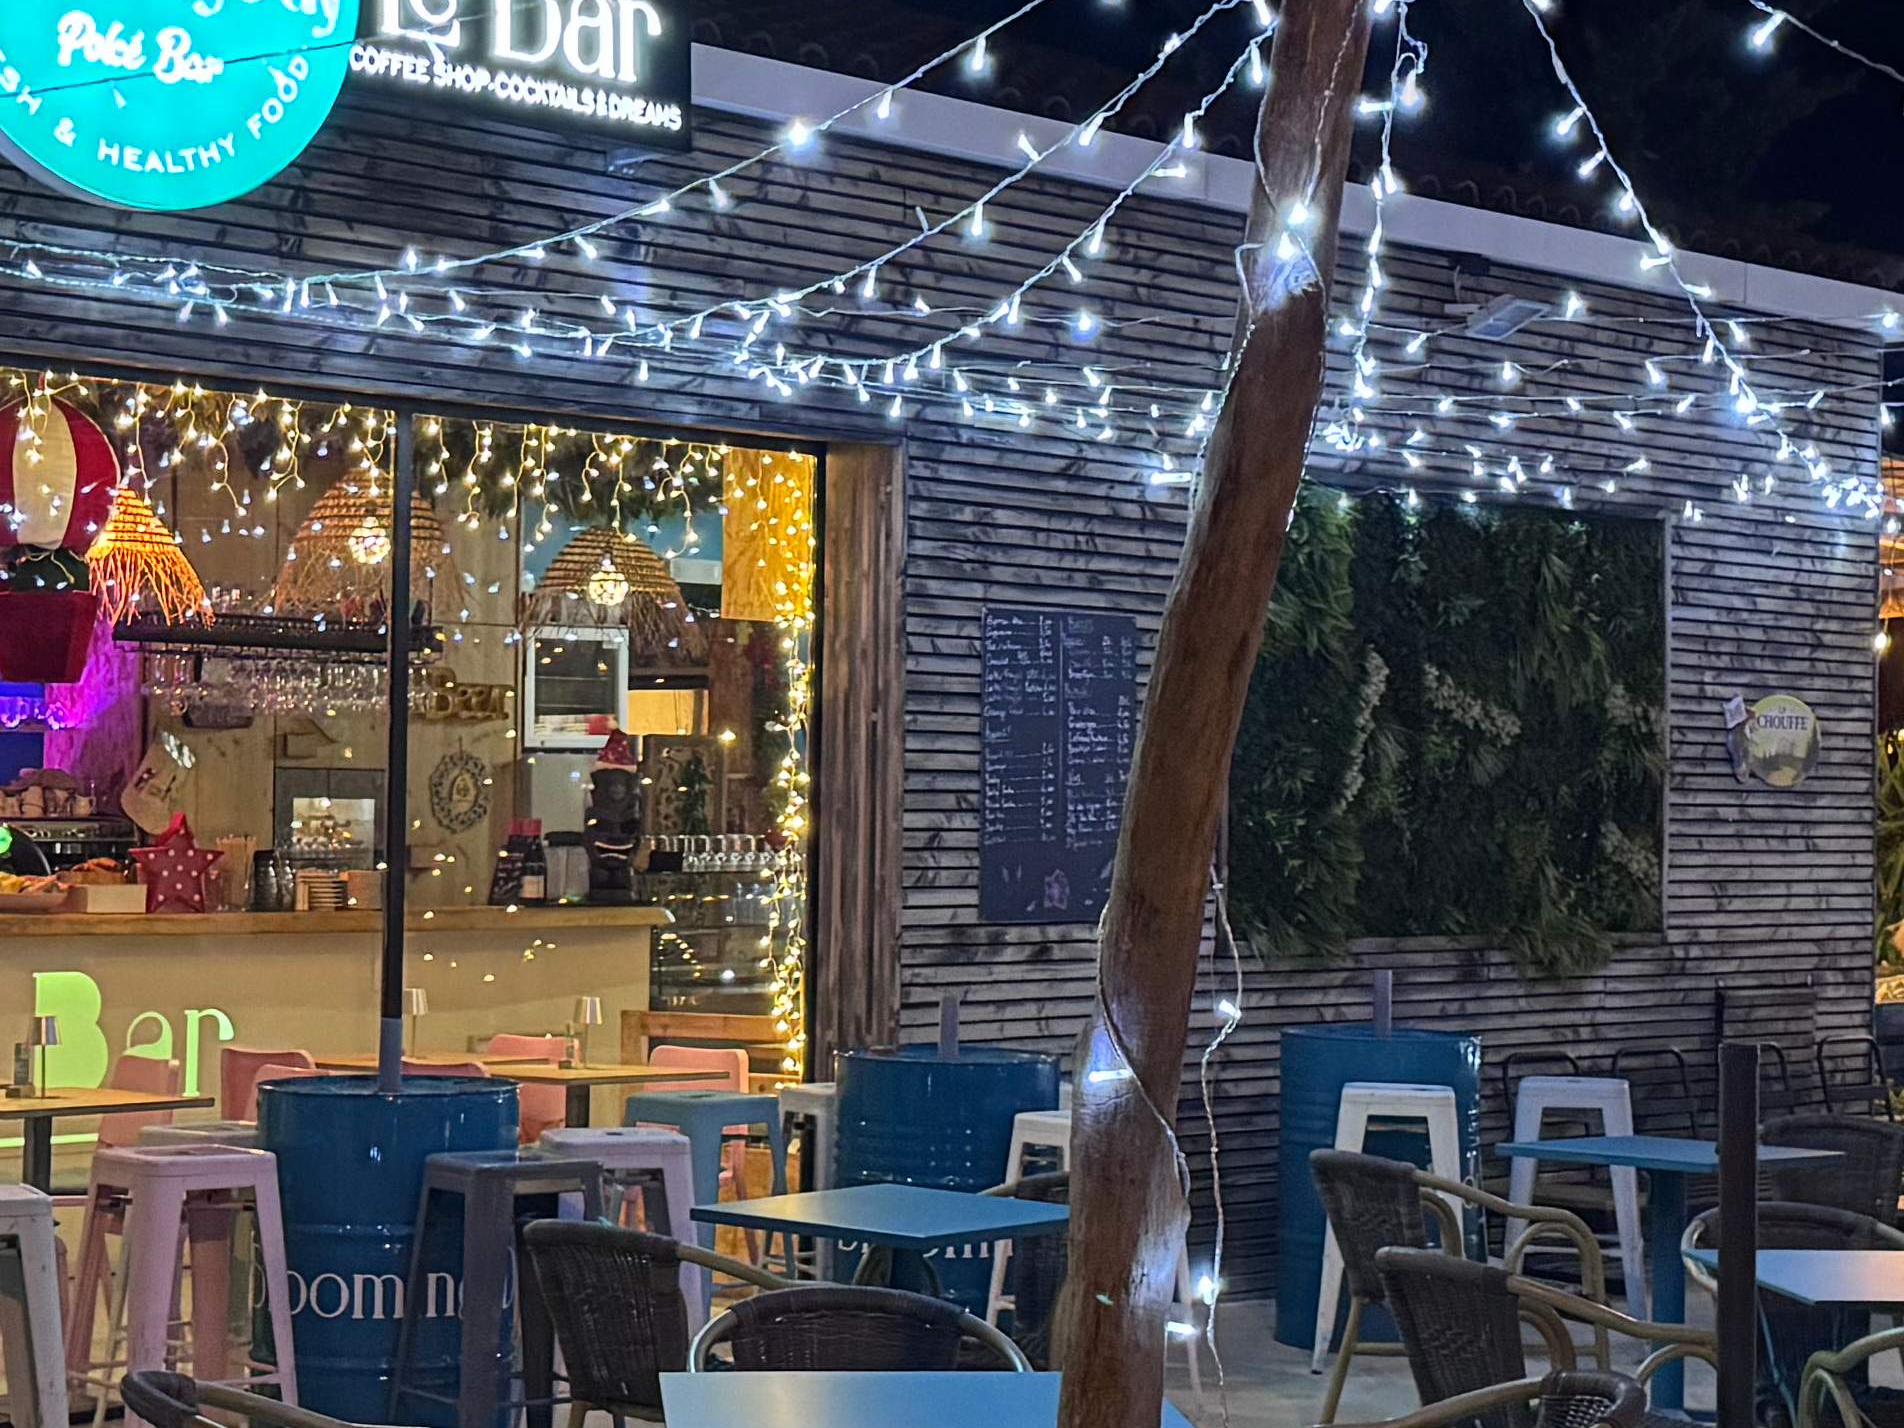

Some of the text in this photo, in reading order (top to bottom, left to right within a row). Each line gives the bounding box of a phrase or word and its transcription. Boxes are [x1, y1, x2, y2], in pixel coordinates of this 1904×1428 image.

[152, 25, 226, 84] Bar
[348, 44, 431, 84] COFFEE
[53, 117, 78, 147] &
[97, 131, 237, 174] HEALTHY
[246, 55, 310, 140] FOOD
[32, 971, 235, 1098] Bar
